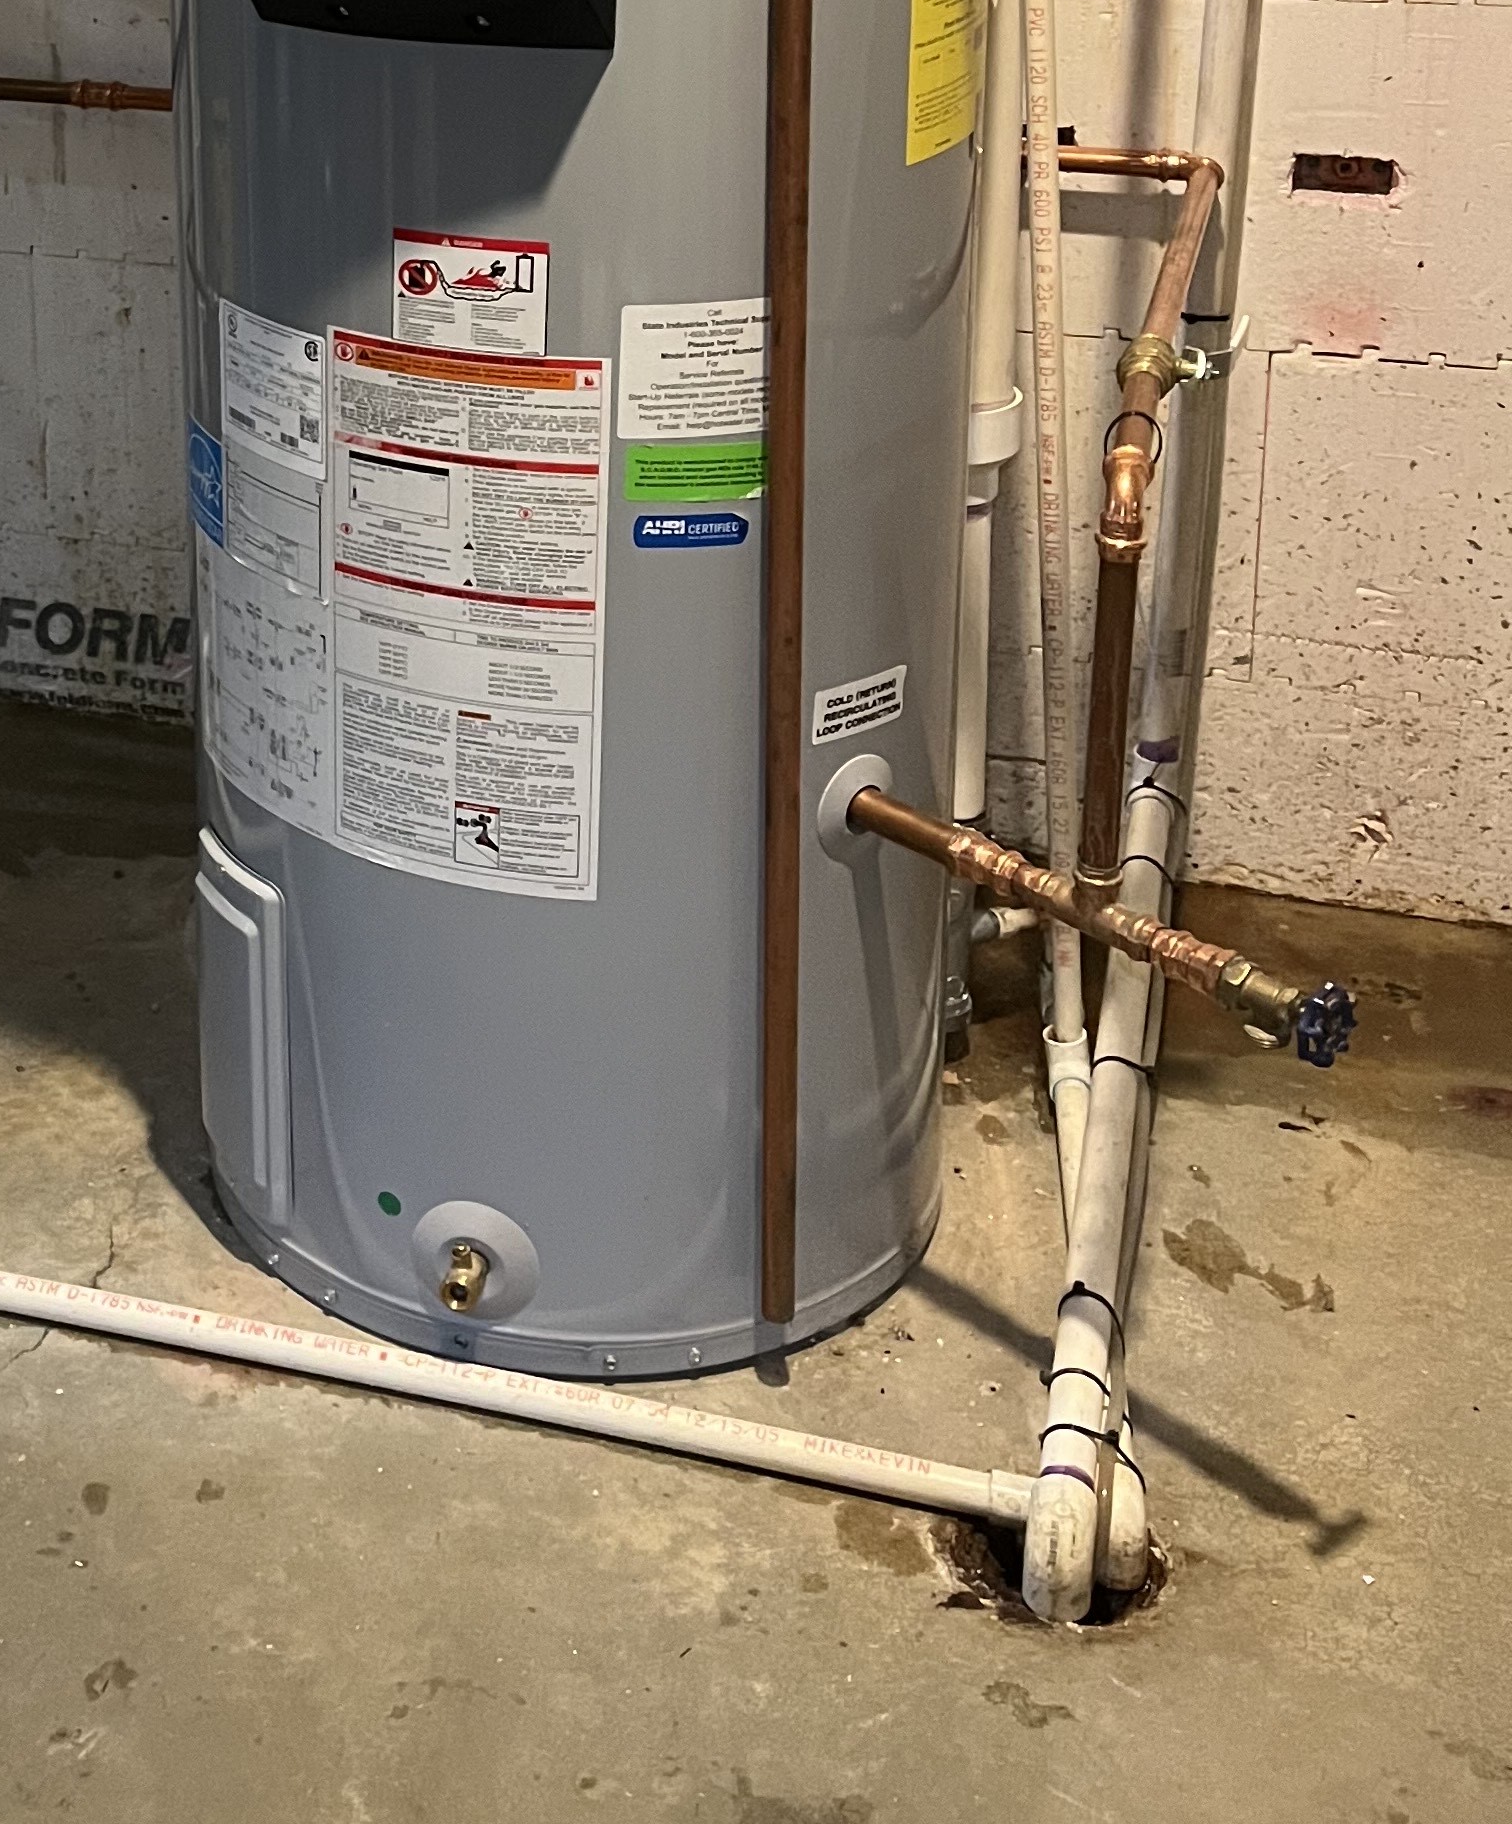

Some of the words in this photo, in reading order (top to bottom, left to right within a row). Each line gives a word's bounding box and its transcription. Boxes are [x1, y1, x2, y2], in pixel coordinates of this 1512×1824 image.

[1029, 7, 1046, 36] PVC
[1029, 49, 1048, 86] 1120
[1031, 95, 1048, 124] SCH
[1033, 133, 1049, 152] 40
[1035, 189, 1051, 218] 600
[1036, 227, 1049, 253] PSI
[1039, 320, 1055, 359] ASTM
[1040, 366, 1057, 423] D-1785
[687, 521, 740, 536] CERTIFIED
[1043, 491, 1061, 565] DRINKING
[1046, 571, 1063, 617] WATER
[113, 669, 187, 696] Form
[1049, 638, 1066, 708] CP-112-P
[823, 691, 897, 723] RECIRCULATING
[826, 694, 854, 709] COLD
[816, 723, 844, 738] LOOP
[845, 702, 902, 730] CONNECTION
[15, 1276, 60, 1297] ASTM
[65, 1288, 130, 1311] D-1785
[215, 1315, 304, 1345] DRINKING
[313, 1335, 370, 1358] WATER
[403, 1353, 498, 1383] CP-112-P
